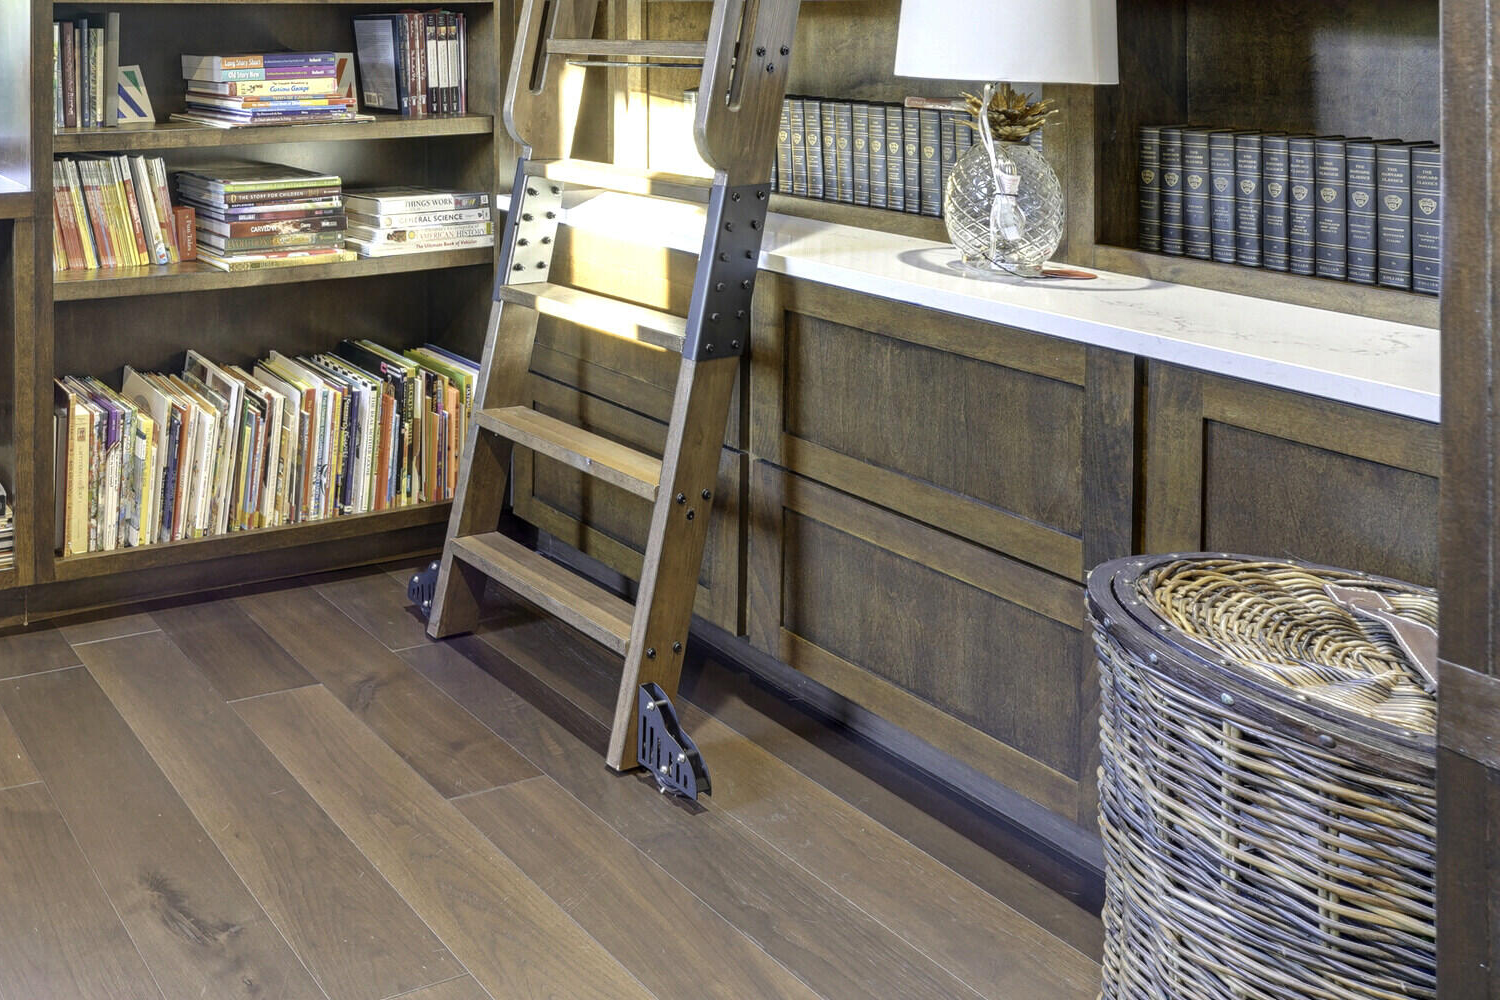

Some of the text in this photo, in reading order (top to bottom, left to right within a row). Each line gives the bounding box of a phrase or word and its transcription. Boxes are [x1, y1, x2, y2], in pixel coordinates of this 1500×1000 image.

[224, 60, 235, 68] Long
[248, 58, 261, 66] Short
[237, 71, 248, 79] Story
[291, 85, 309, 93] George
[405, 200, 430, 208] THINGS
[416, 228, 485, 239] AMERICAN HISTORY
